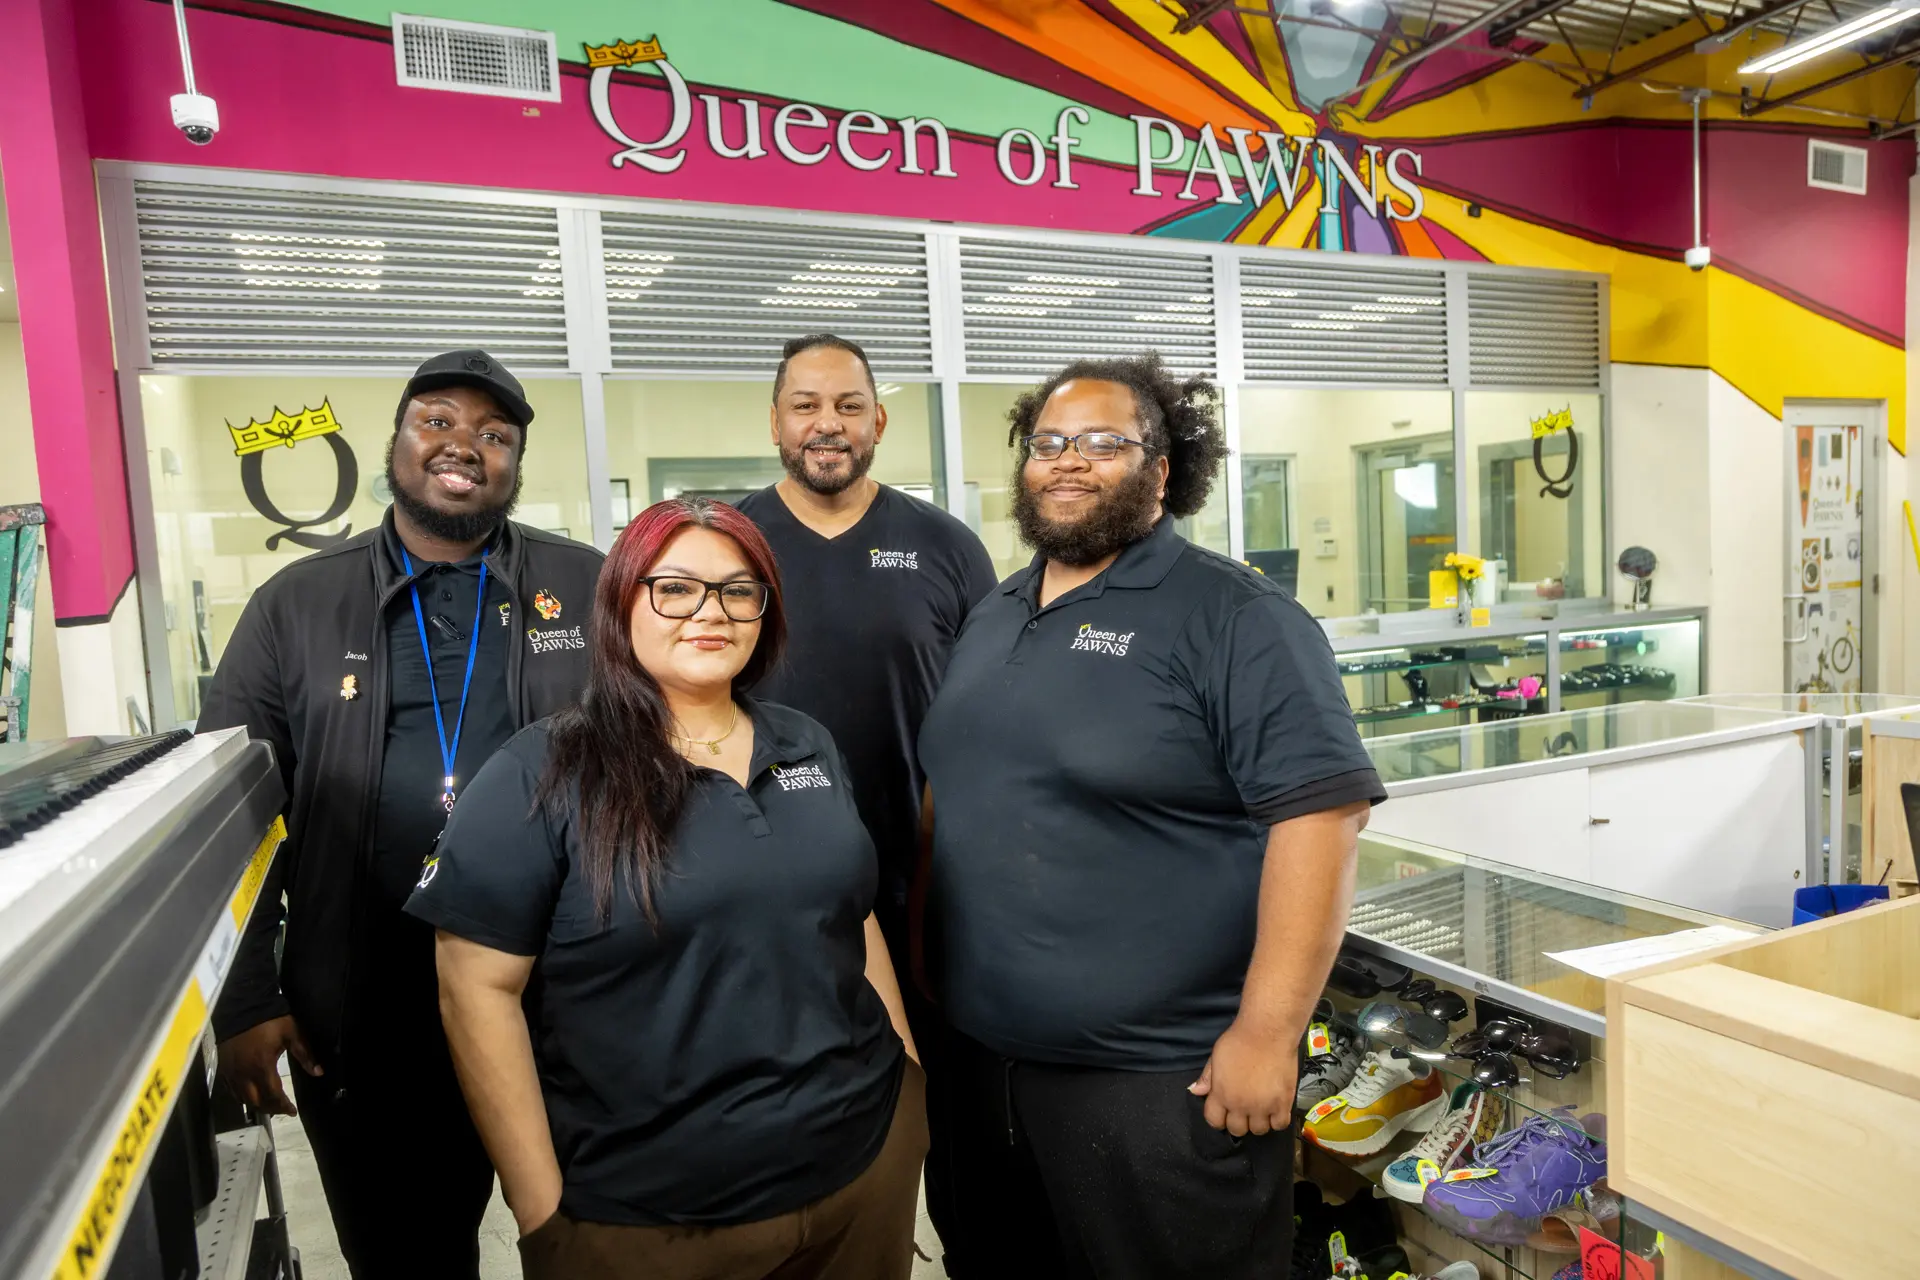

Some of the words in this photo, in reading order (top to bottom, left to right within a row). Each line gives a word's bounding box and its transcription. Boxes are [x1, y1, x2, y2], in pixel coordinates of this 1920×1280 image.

[590, 58, 958, 174] Queen
[997, 106, 1090, 189] of
[1129, 113, 1426, 223] PAWNS
[870, 549, 904, 559] Queen
[906, 551, 918, 560] of
[871, 558, 918, 570] PAWNS
[528, 628, 568, 643] Queen
[570, 626, 581, 637] of
[1078, 624, 1117, 641] Queen
[1118, 632, 1135, 644] of
[531, 638, 586, 654] PAWNS
[1070, 638, 1129, 657] PAWNS
[345, 650, 368, 661] Jacob
[771, 764, 813, 780] Queen
[811, 764, 823, 776] of
[778, 776, 832, 791] PAWNS
